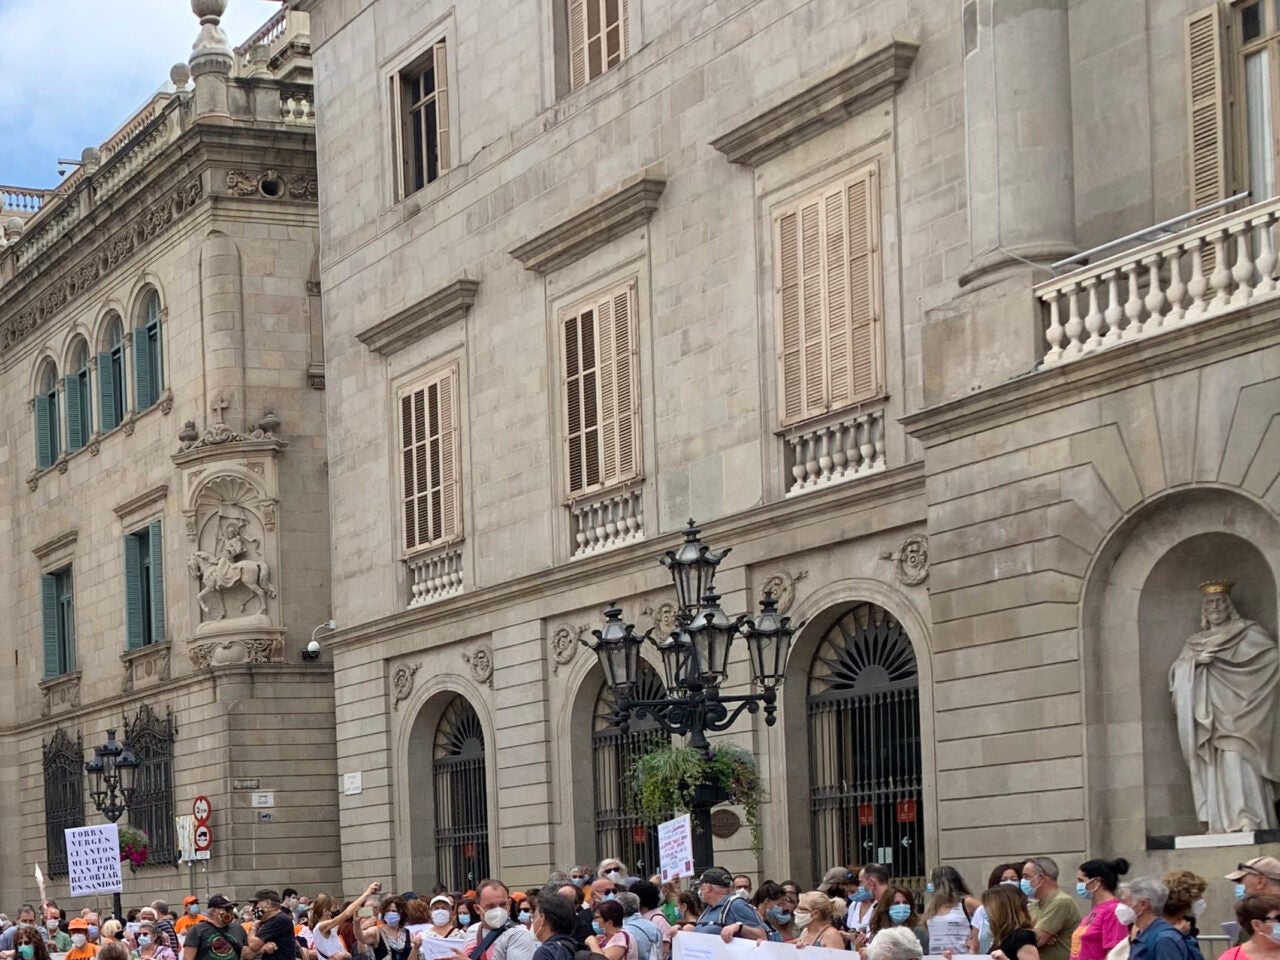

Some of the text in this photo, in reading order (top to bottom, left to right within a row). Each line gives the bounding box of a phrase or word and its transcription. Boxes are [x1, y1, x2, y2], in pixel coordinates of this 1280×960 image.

[72, 829, 103, 838] TORRA
[71, 847, 114, 857] CUANTOS
[72, 857, 116, 867] MUERTOS
[73, 864, 115, 875] VAN POR
[72, 872, 118, 884] RECORTAR
[72, 880, 121, 892] EN SANIDAD
